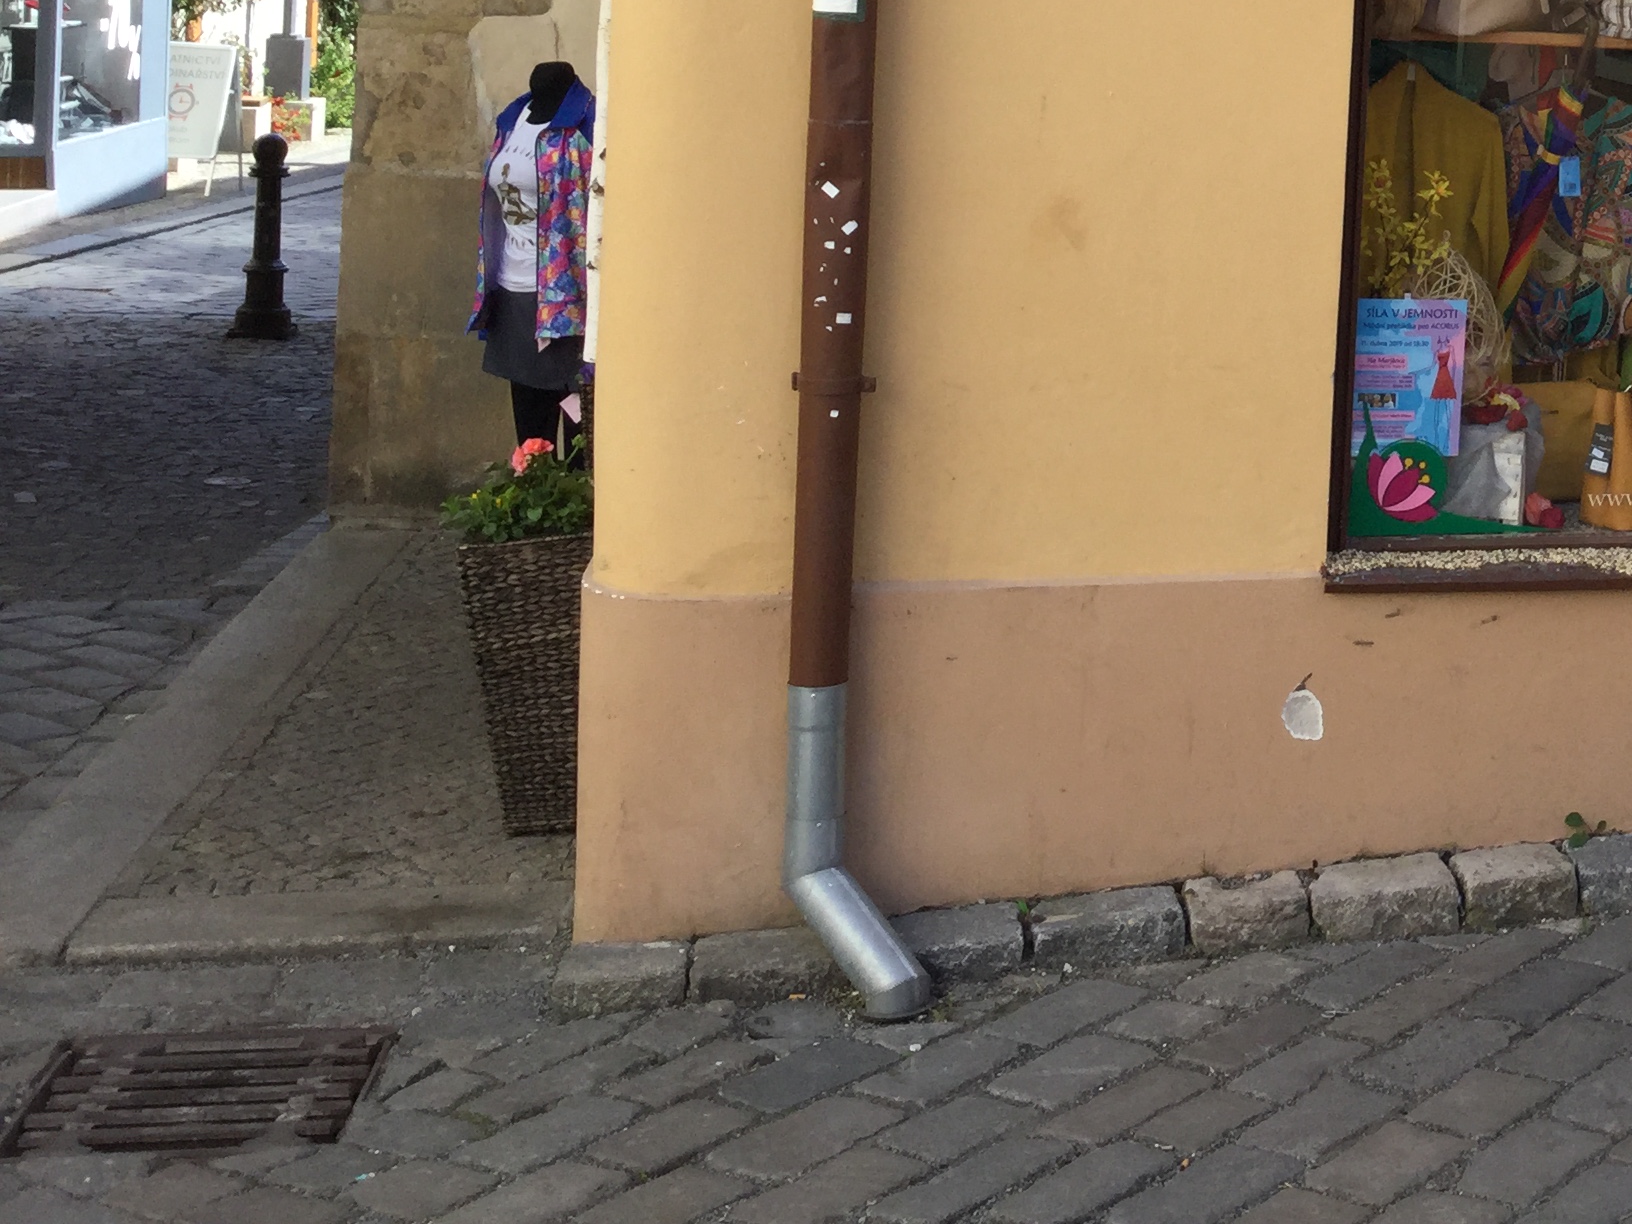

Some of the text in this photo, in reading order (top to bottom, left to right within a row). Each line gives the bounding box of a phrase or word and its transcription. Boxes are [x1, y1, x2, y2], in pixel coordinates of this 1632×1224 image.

[1366, 306, 1458, 319] SÍLA V JEMNOSTI
